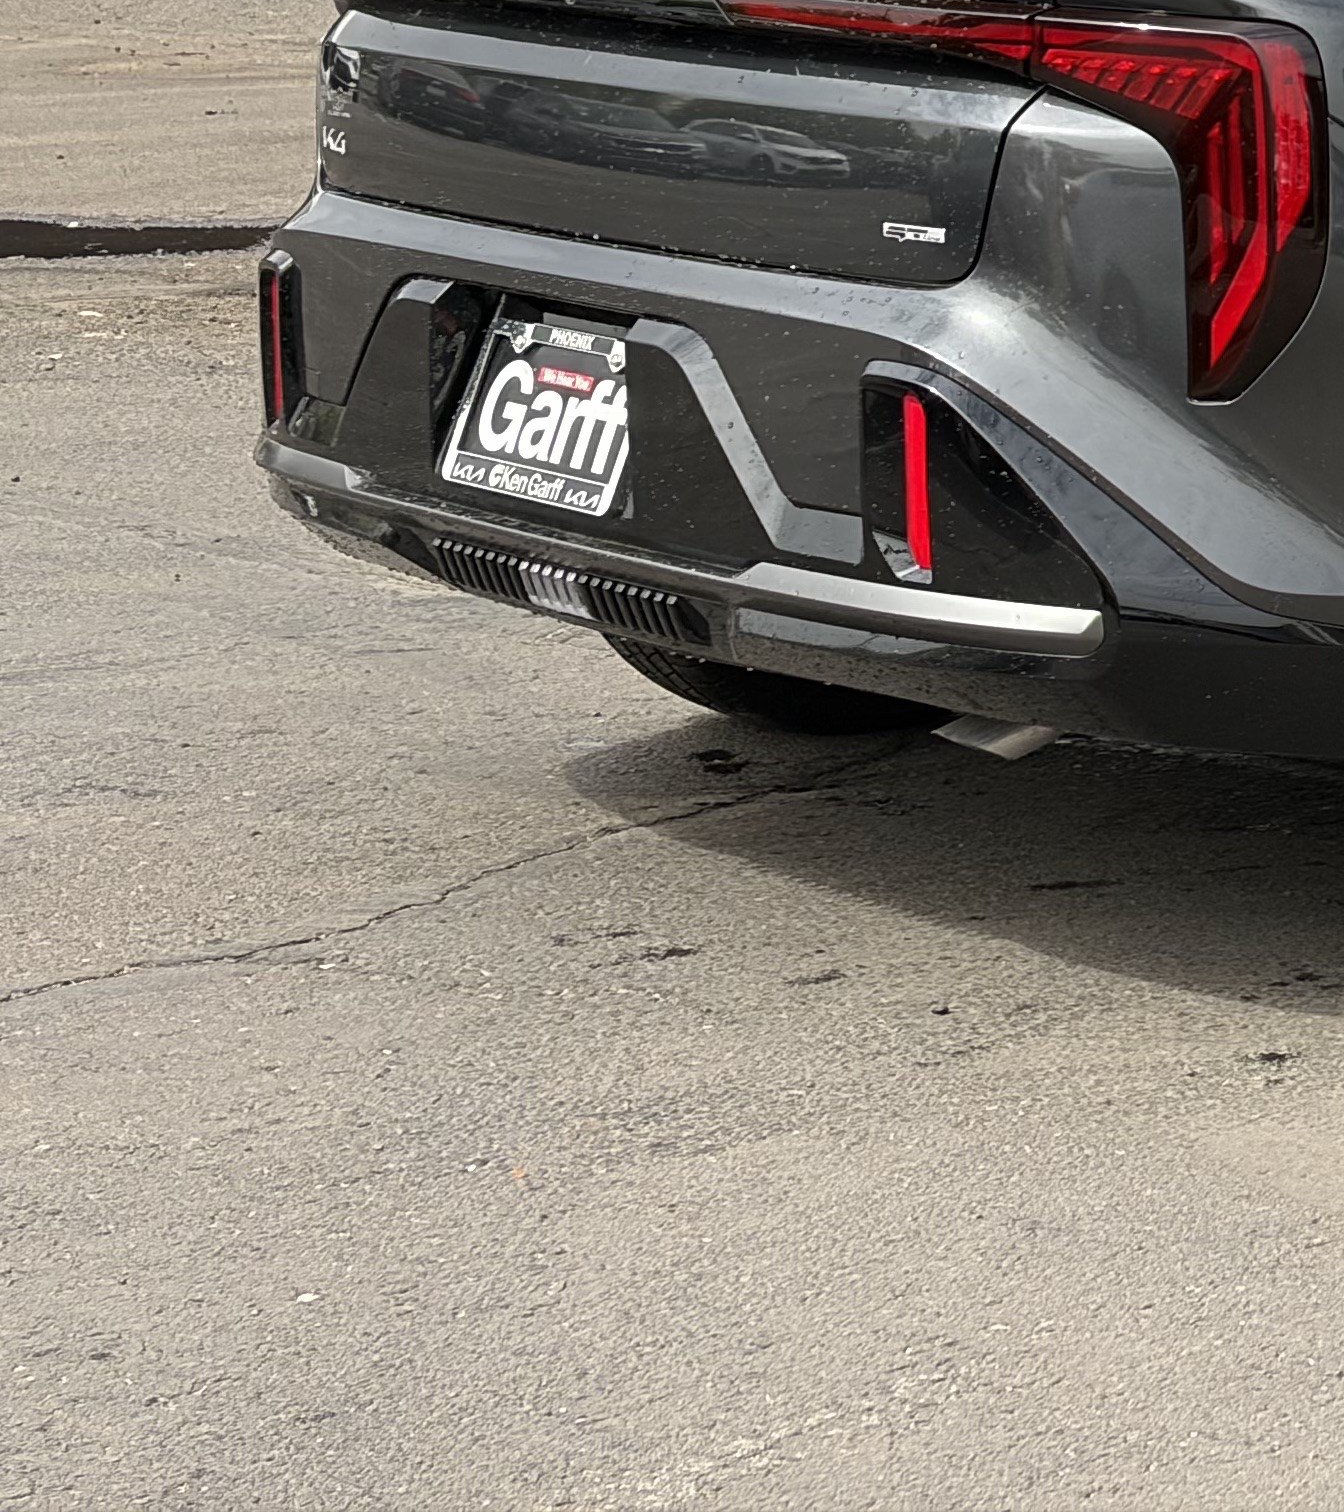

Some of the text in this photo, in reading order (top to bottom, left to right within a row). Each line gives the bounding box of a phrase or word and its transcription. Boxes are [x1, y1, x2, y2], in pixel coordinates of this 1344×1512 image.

[322, 125, 347, 155] K4
[549, 327, 596, 351] PHOENIX
[478, 359, 628, 474] Garff
[500, 465, 529, 493] Ken
[527, 473, 566, 501] Garff
